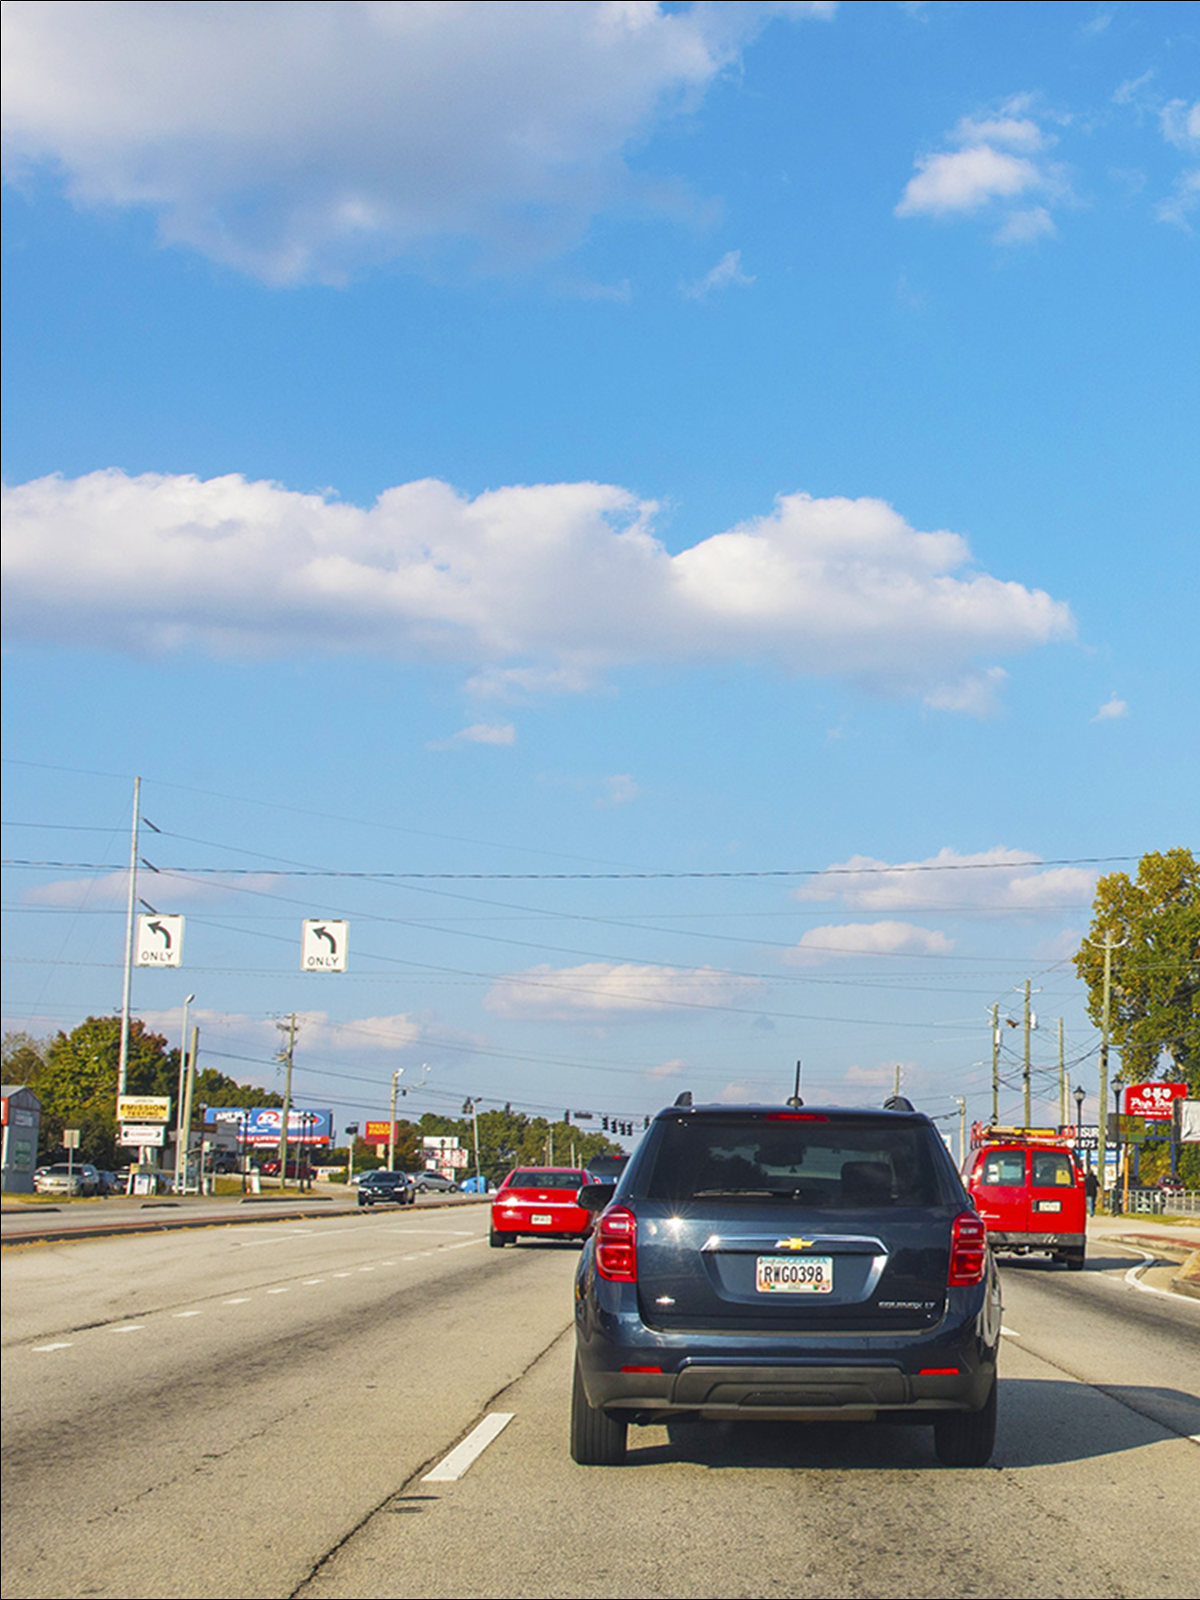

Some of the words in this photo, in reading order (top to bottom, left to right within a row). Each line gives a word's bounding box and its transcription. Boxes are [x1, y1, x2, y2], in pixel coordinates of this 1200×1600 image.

[141, 951, 174, 962] ONLY
[307, 956, 339, 967] ONLY
[764, 1266, 824, 1283] RWG0398
